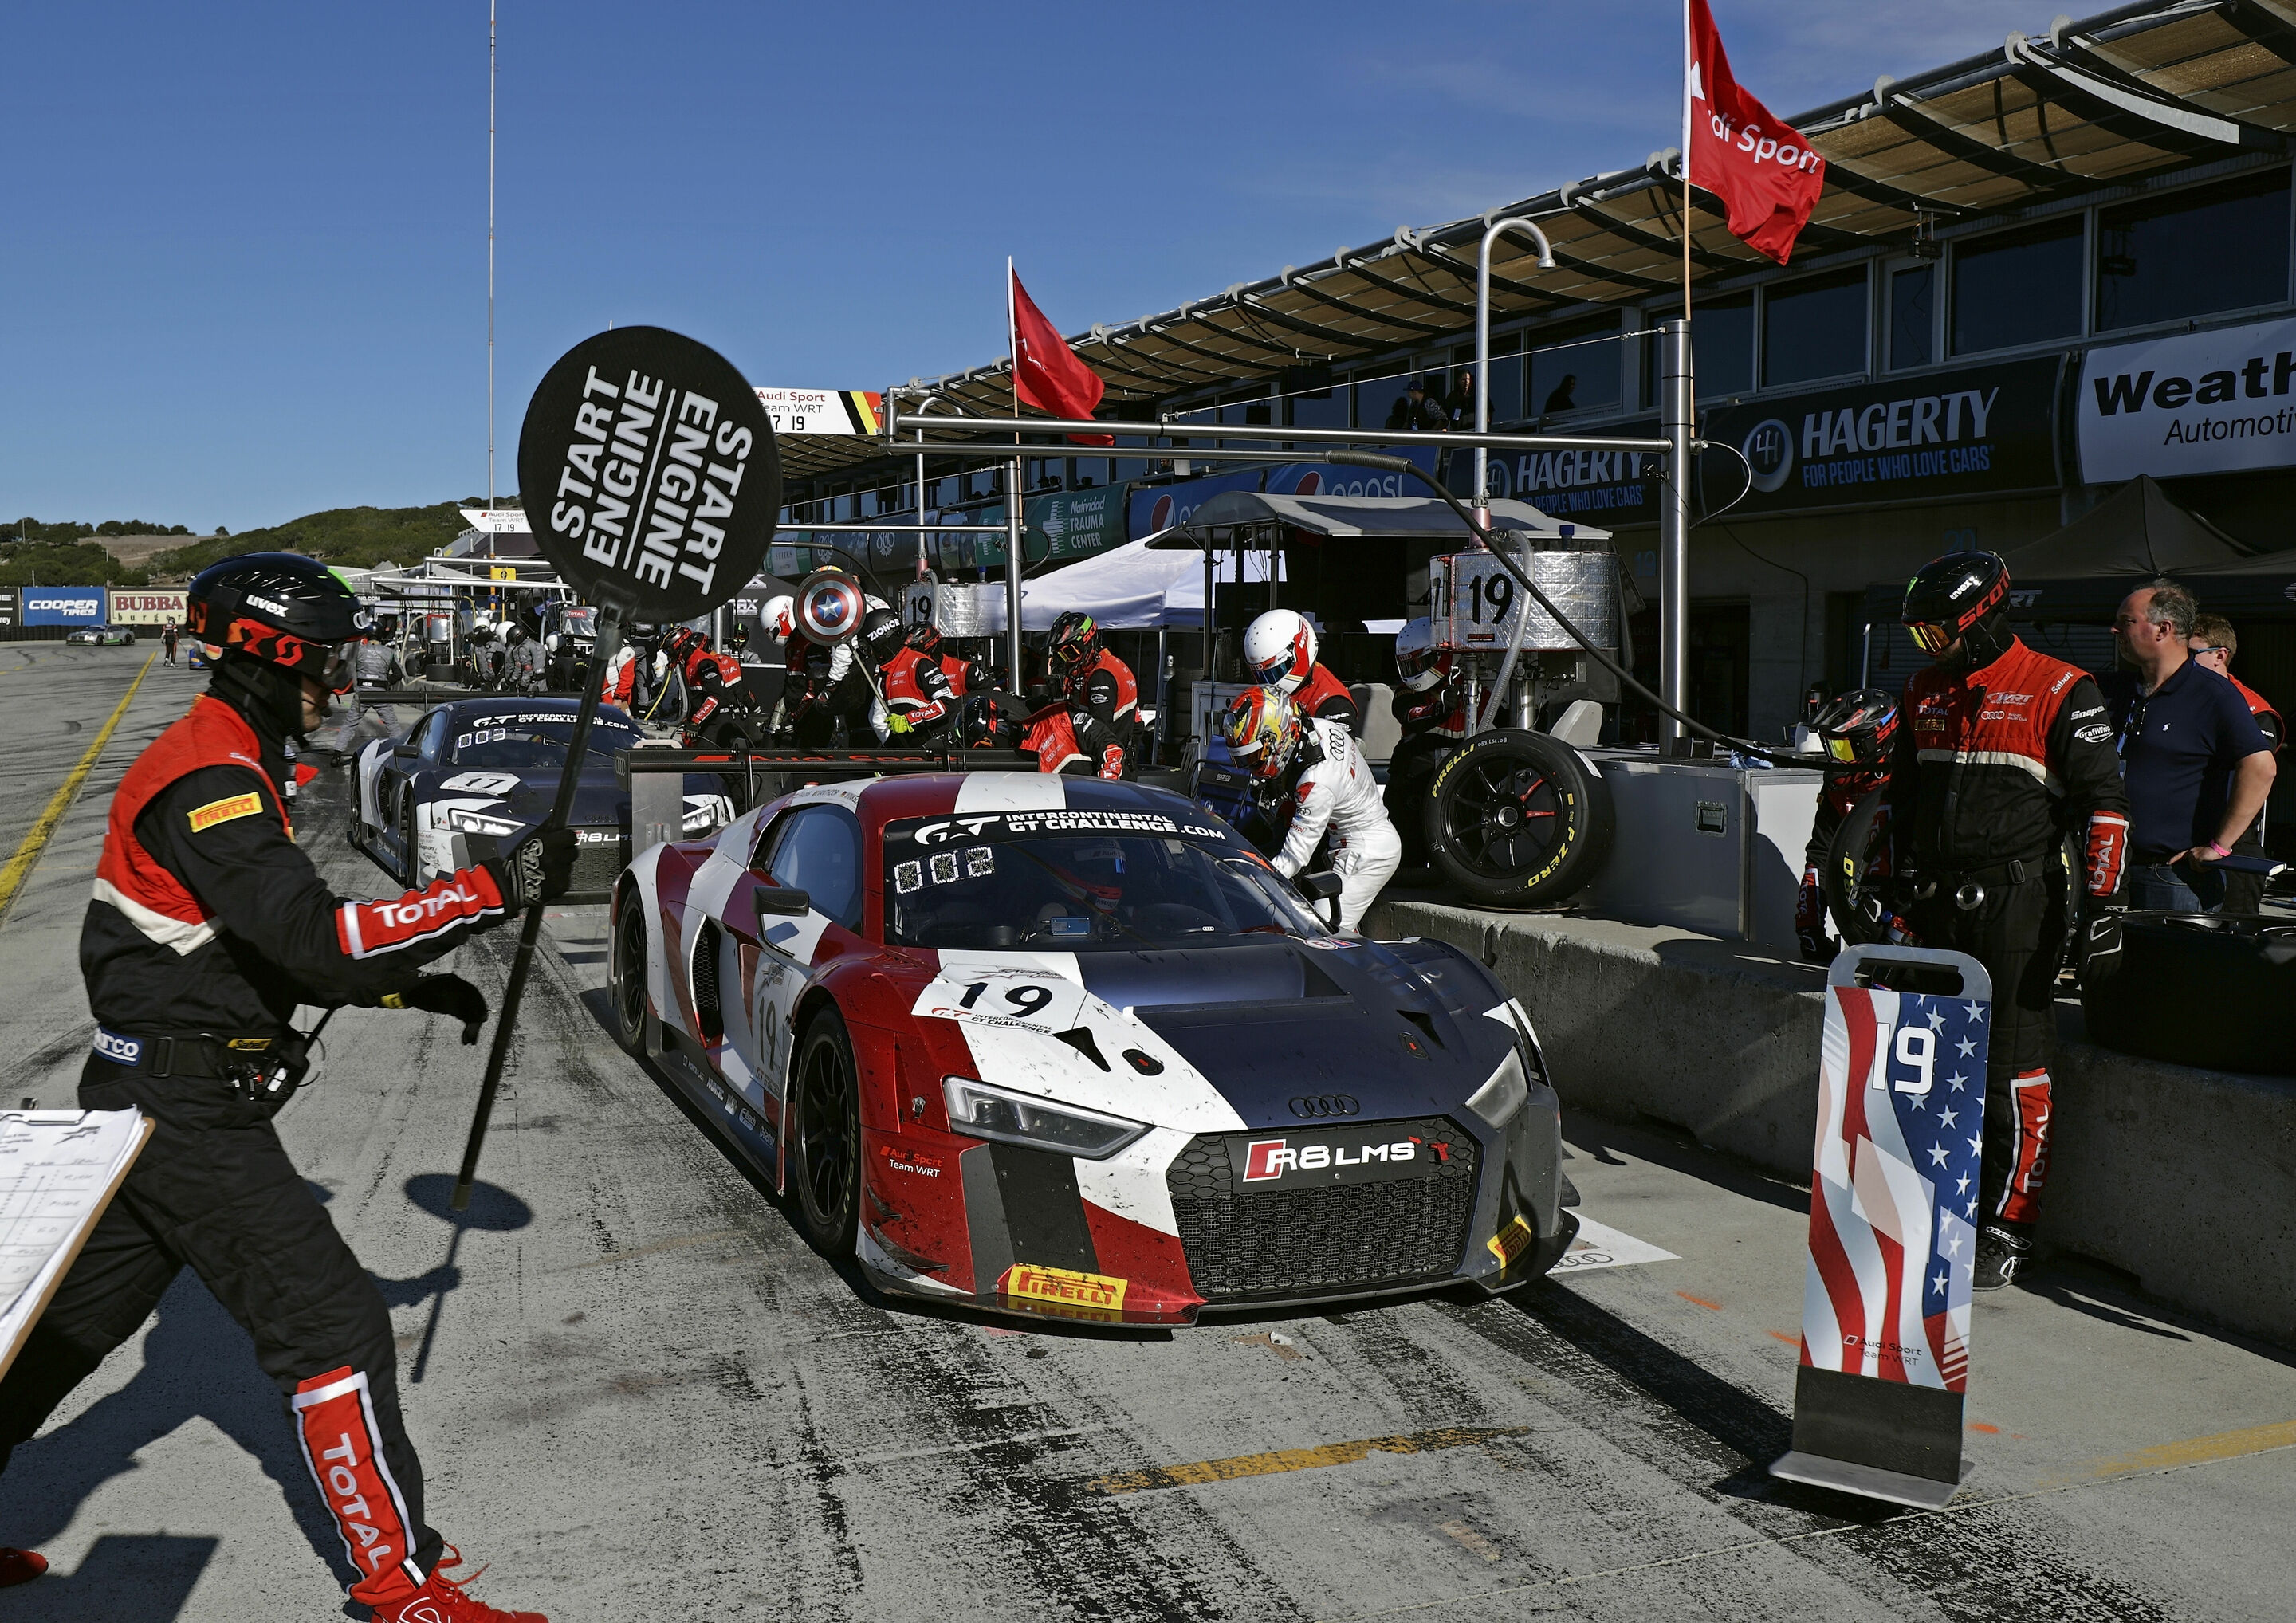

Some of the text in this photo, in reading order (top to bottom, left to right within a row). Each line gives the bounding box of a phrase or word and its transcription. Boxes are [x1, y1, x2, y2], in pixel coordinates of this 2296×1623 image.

[1708, 110, 1821, 174] di Sport
[758, 391, 825, 402] Audi Sport
[794, 404, 824, 413] WRT
[792, 416, 804, 430] 19
[1802, 387, 2000, 458] HAGERTY
[2164, 407, 2296, 446] Automoti
[551, 365, 619, 539] START
[583, 369, 664, 568] ENGINE
[1516, 450, 1644, 493] HAGERTY
[1803, 446, 1991, 488] FOR PEOPLE WHO LOVE CARS
[635, 390, 719, 591] ENGINE
[1568, 491, 1590, 511] WHO
[1592, 485, 1617, 510] LOVE
[1618, 484, 1643, 506] CARS
[678, 420, 753, 595] START
[1070, 494, 1106, 513] Natividad
[1070, 514, 1105, 532] TRAUMA
[1071, 535, 1103, 549] CENTER
[1469, 573, 1514, 624] 19
[1950, 578, 1973, 600] uvex
[29, 599, 99, 610] COOPER
[114, 596, 184, 611] BUBBA
[246, 595, 289, 617] uvex
[910, 596, 931, 623] 19
[564, 619, 574, 634] A
[867, 619, 901, 641] ZIONOR
[2051, 670, 2074, 694] Sabelt
[696, 704, 713, 719] TOTAL
[910, 709, 937, 719] TOTAL
[1917, 705, 1950, 717] TOTAL
[1432, 744, 1475, 797] PIRELLI
[466, 778, 507, 788] 17
[195, 798, 255, 826] PIRELLI
[1006, 813, 1173, 823] INTERCONTINENTAL
[1008, 820, 1044, 833] GT
[1523, 843, 1569, 889] ZERO
[2086, 833, 2115, 891] TOTAL
[372, 883, 478, 928] TOTAL
[958, 982, 1052, 1018] 19
[974, 1014, 1052, 1030] INTERCONTINENTAL
[988, 1020, 1051, 1034] CHALLENGE
[92, 1028, 139, 1057] arco
[759, 996, 776, 1072] 19
[1872, 1023, 1936, 1094] 19
[914, 1153, 942, 1167] Sport
[1335, 1142, 1415, 1165] LMS
[2021, 1104, 2051, 1193] TOTAL
[890, 1158, 941, 1178] Team WRT
[1018, 1271, 1116, 1305] PIRELLI
[1858, 1348, 1919, 1366] Team WRT
[1860, 1338, 1921, 1356] Audi Sport
[323, 1432, 391, 1572] TOTAL
